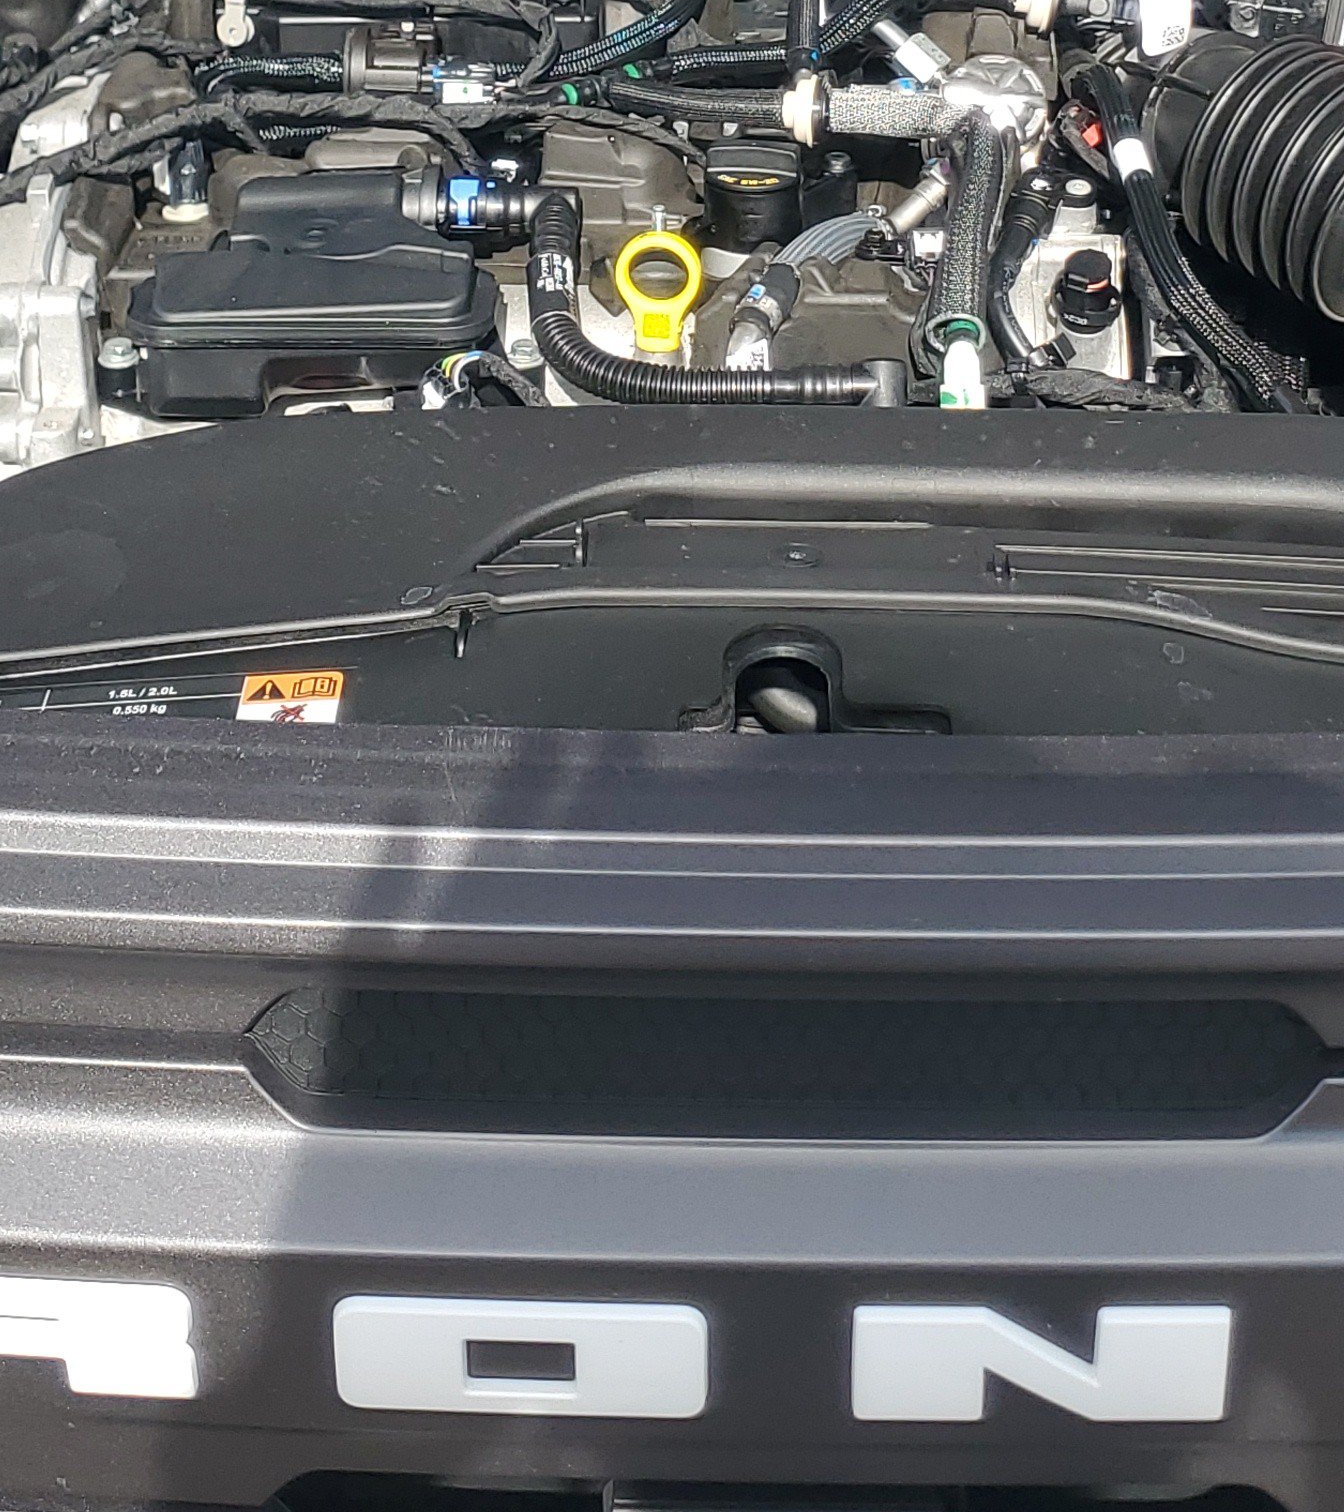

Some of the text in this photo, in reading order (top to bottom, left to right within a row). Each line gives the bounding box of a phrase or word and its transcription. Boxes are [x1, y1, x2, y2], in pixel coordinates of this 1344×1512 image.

[148, 686, 178, 696] 2.0L
[112, 703, 167, 716] 0.550 kg
